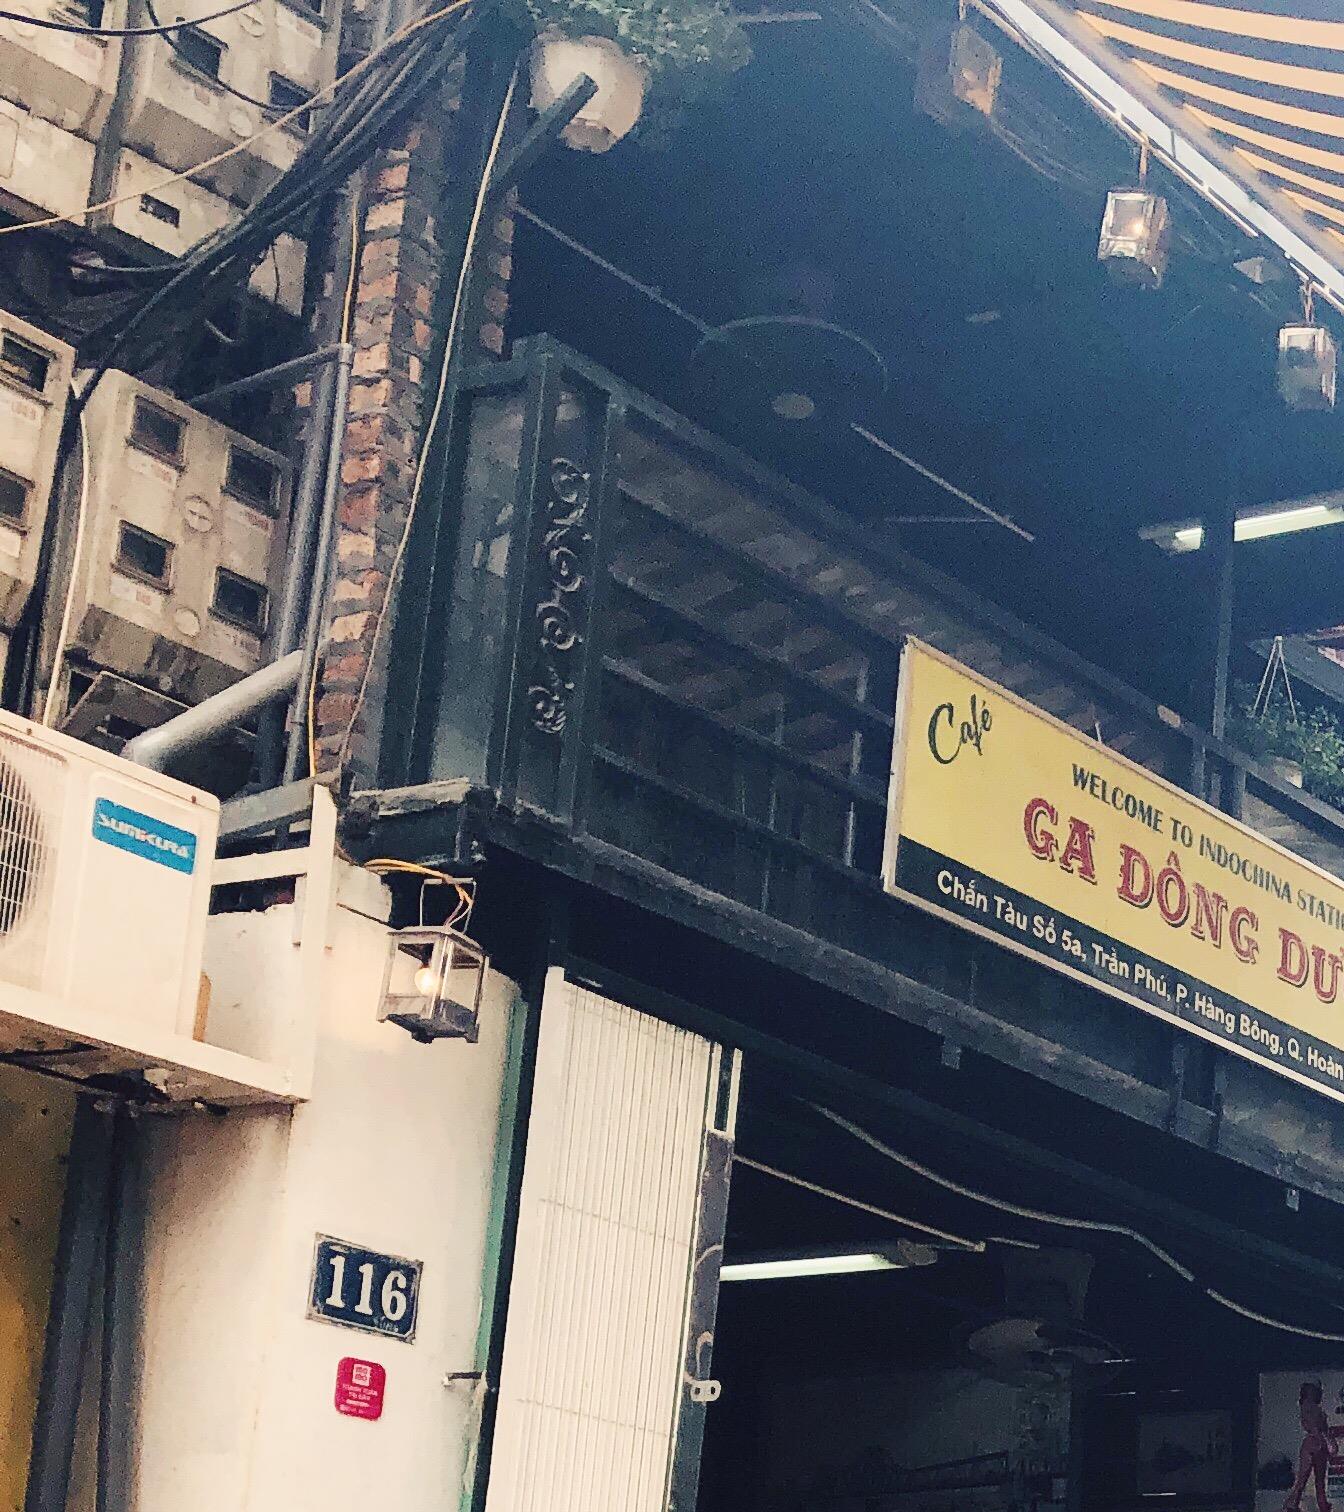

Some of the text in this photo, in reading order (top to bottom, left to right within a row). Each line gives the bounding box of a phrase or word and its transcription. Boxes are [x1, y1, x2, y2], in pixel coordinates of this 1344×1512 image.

[927, 693, 993, 764] Café
[1023, 797, 1098, 886] GA
[1071, 762, 1164, 835] WELCOME
[1170, 815, 1193, 848] TO
[1199, 833, 1292, 904] INDOCHINA
[993, 893, 1029, 932] Tàu
[1032, 913, 1057, 945] Số
[1061, 929, 1087, 962] 5a,
[1091, 942, 1130, 979] Trần
[1134, 962, 1172, 1002] Phú,
[1175, 983, 1190, 1009] P.
[1194, 991, 1236, 1034] Hàng
[1239, 1013, 1284, 1057] Bông,
[1287, 1037, 1304, 1063] Q.
[1307, 1045, 1344, 1082] Hoàn
[325, 1254, 408, 1322] 116
